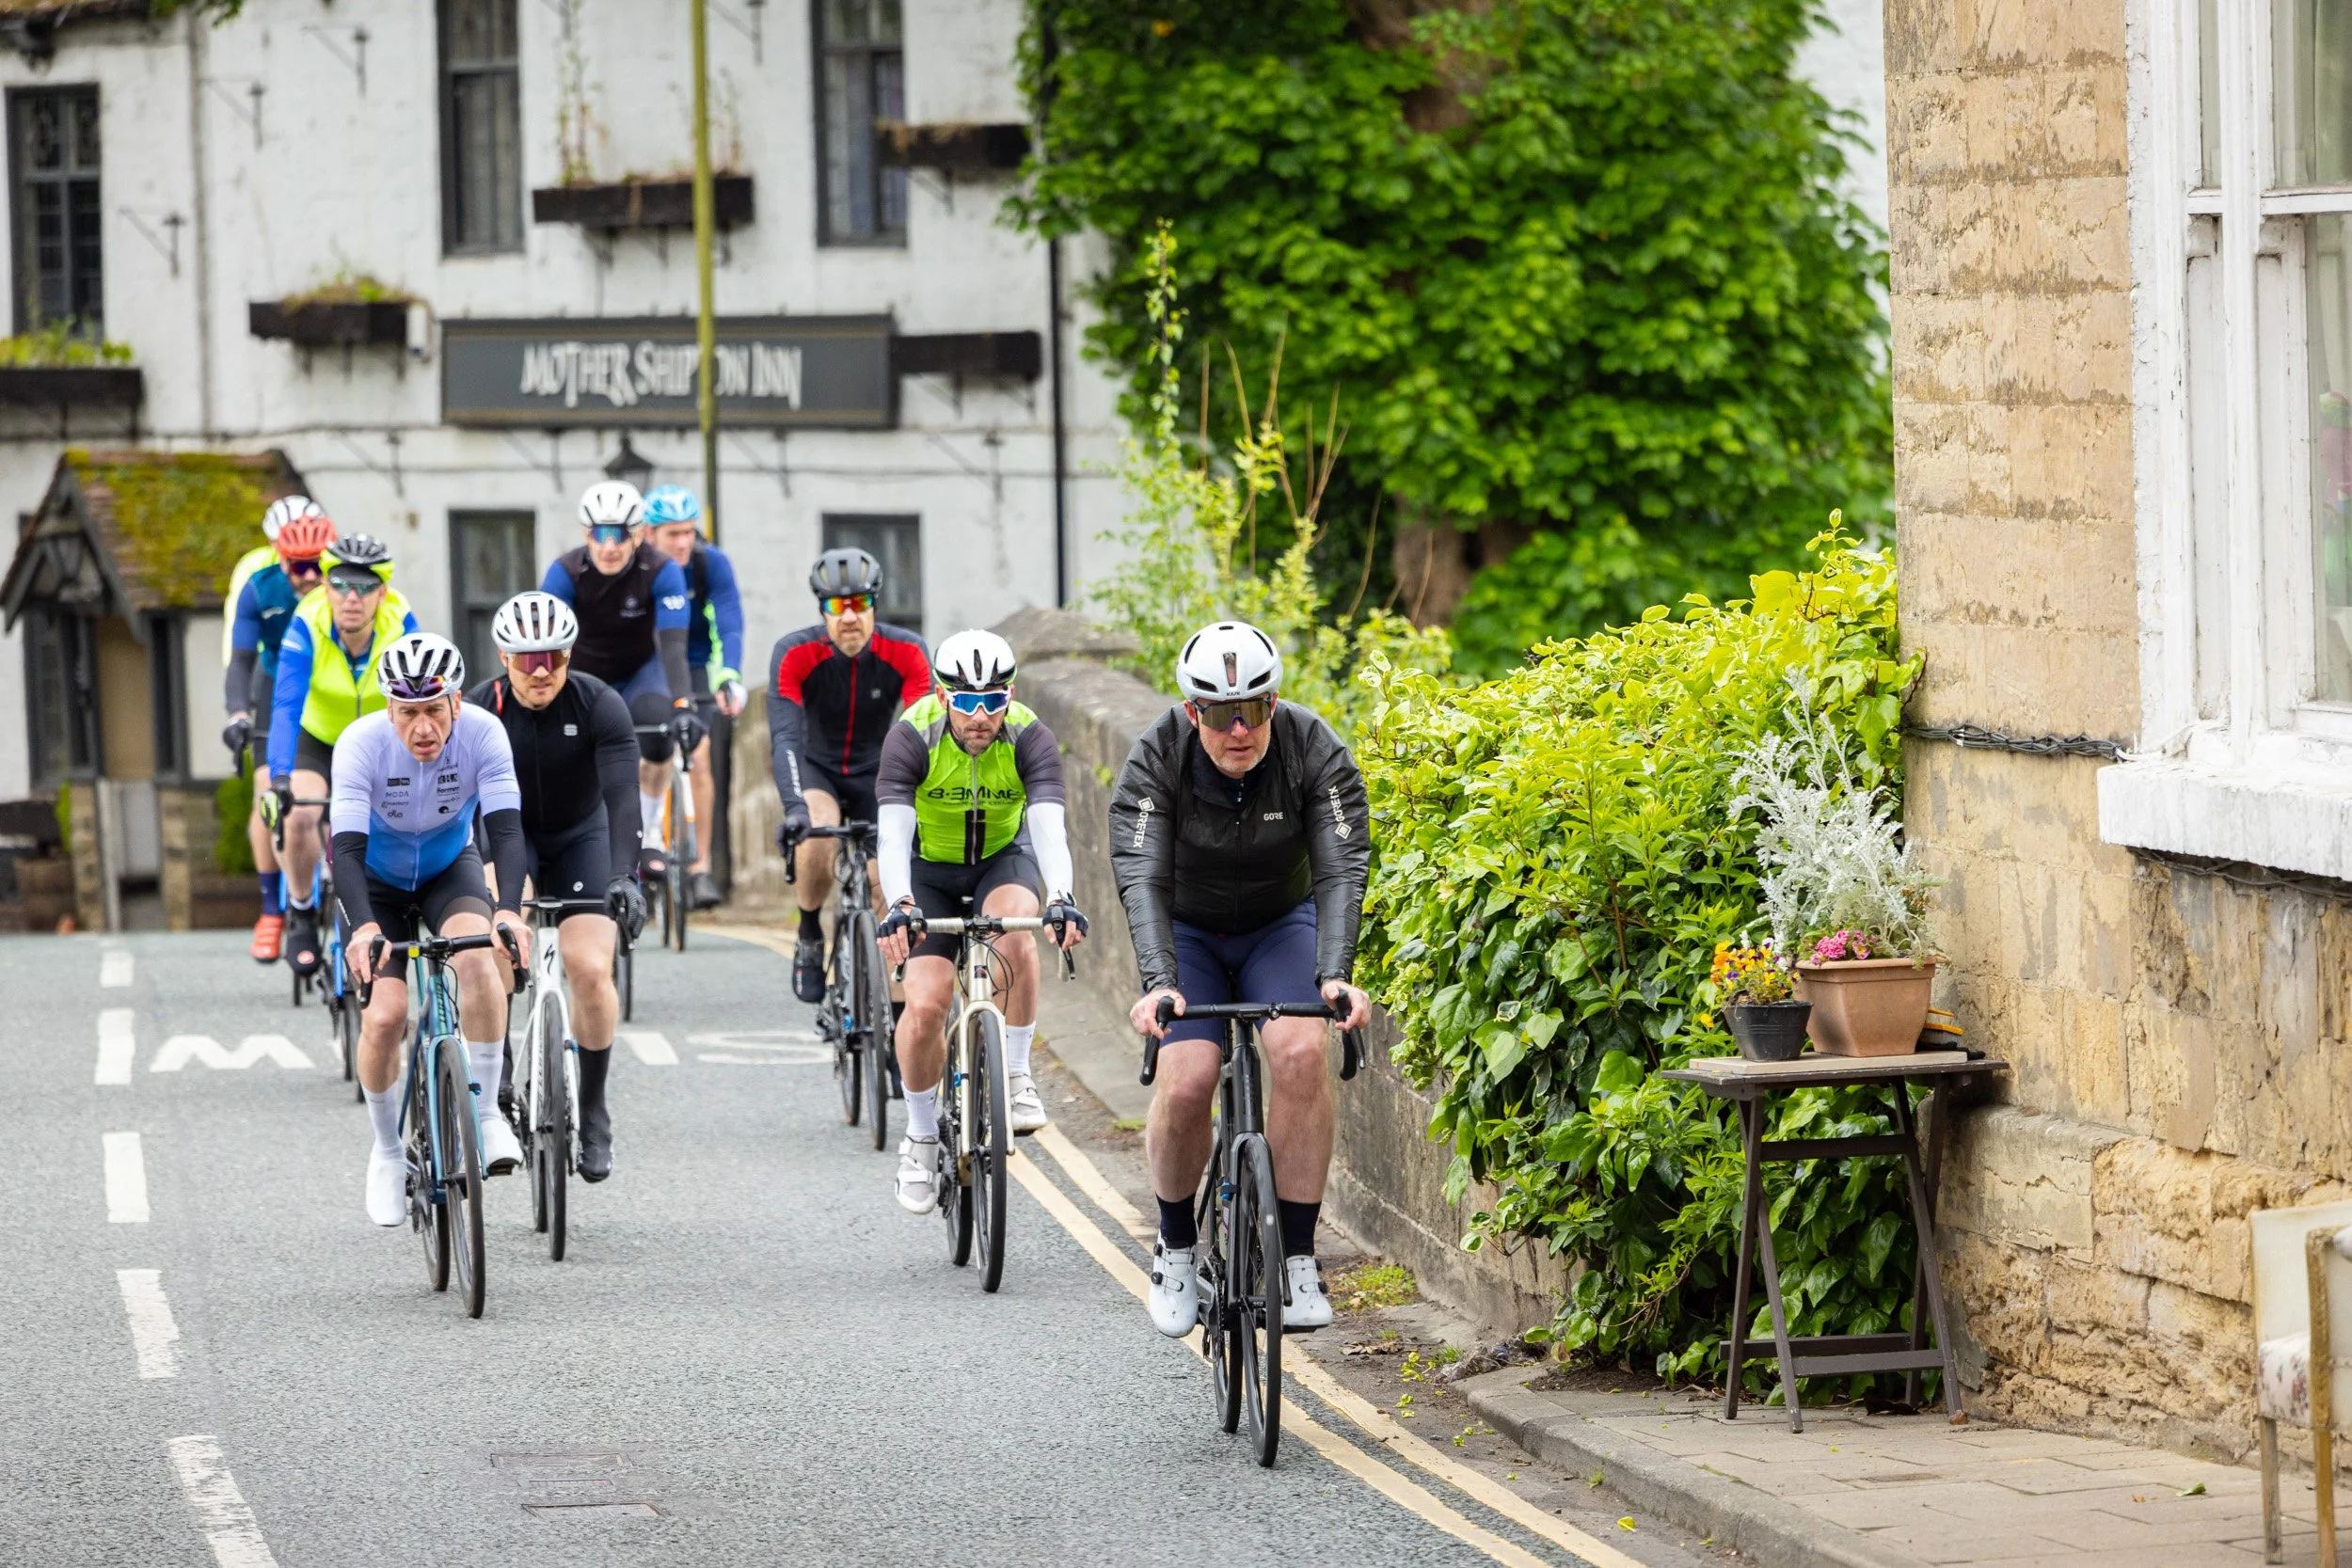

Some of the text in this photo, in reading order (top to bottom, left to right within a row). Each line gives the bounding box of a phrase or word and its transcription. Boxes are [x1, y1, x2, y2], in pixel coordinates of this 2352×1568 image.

[520, 340, 803, 411] MOTHER SHIPON INN
[1263, 812, 1284, 821] GORE
